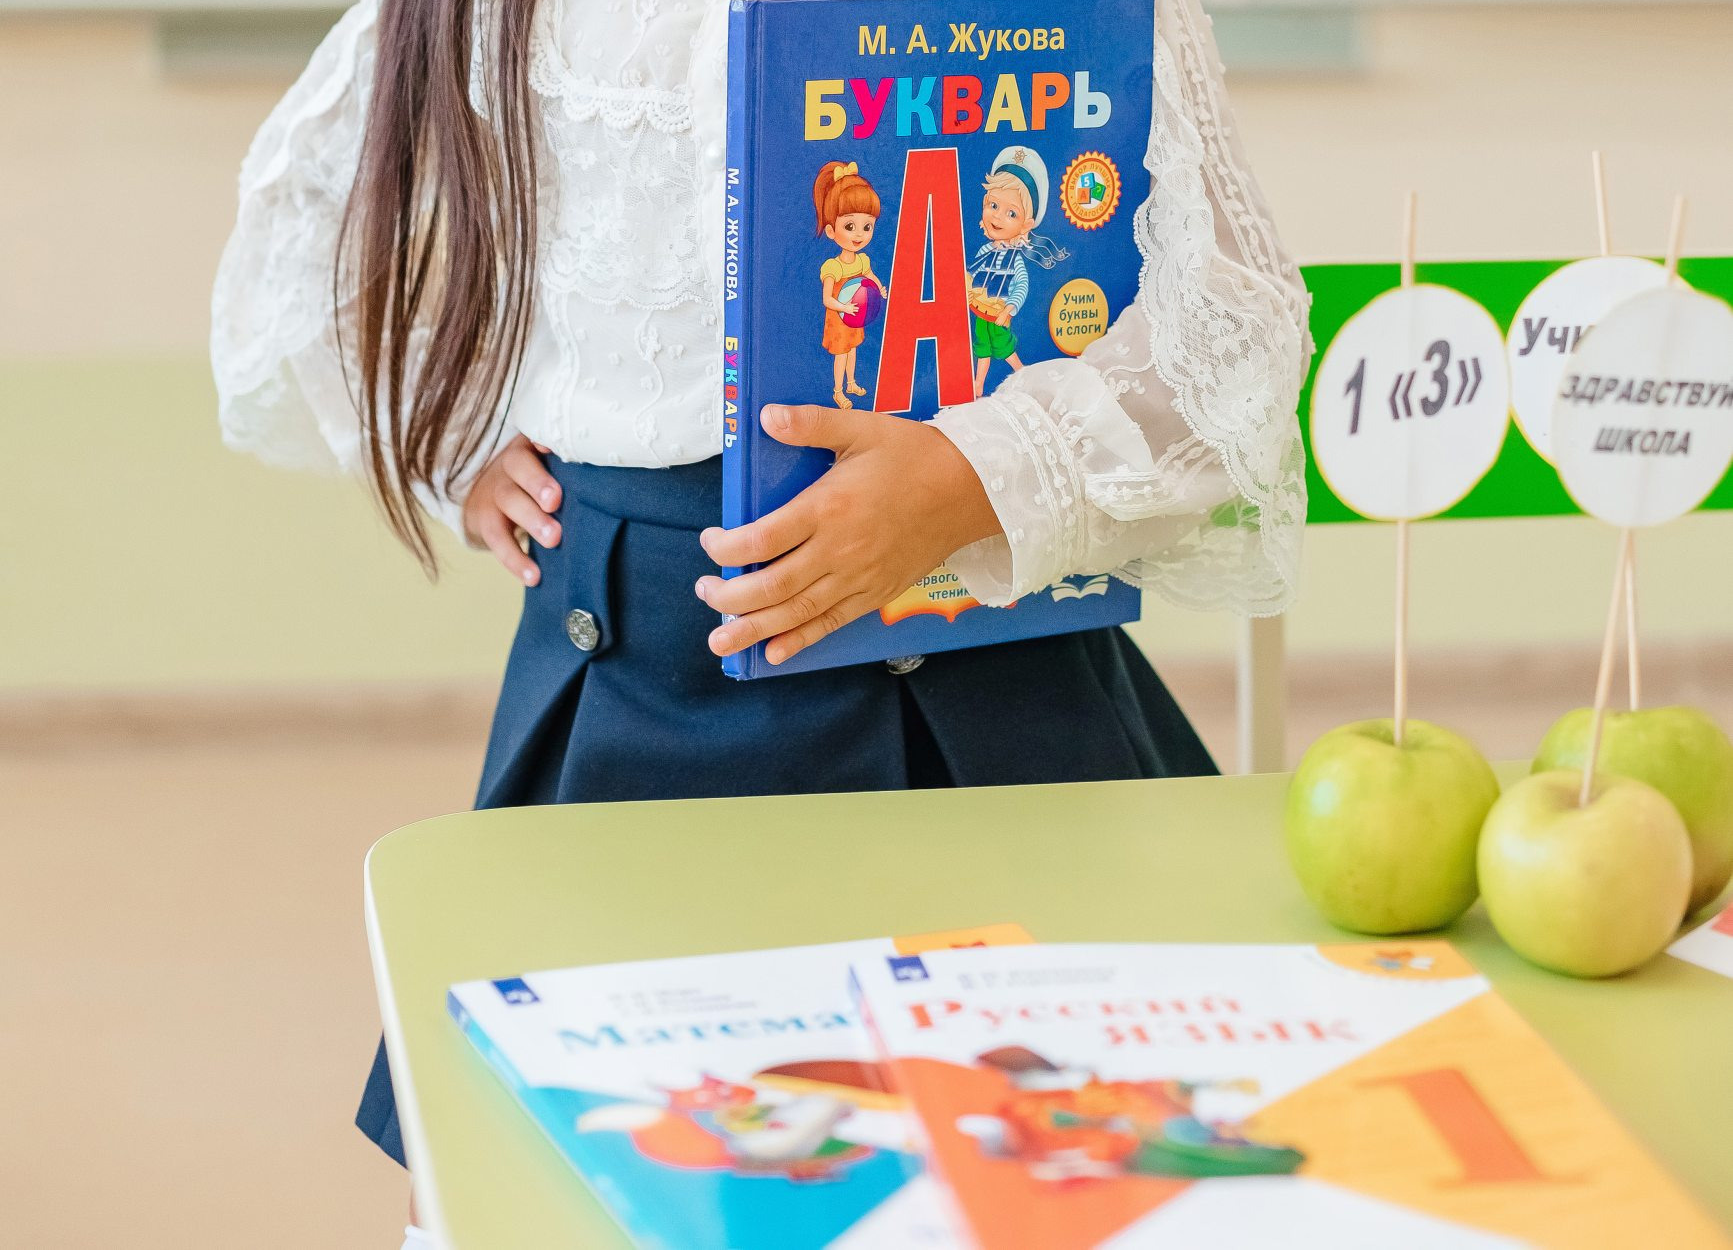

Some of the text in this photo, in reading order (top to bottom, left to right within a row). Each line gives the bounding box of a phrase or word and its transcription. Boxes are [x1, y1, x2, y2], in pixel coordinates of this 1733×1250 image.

[857, 22, 1066, 61] М. А. Жукова
[803, 70, 1113, 142] БУКВАРЬ
[726, 168, 740, 301] М. А. ЖУКОВА
[1059, 308, 1098, 323] буквы
[1063, 293, 1095, 305] Учим
[1056, 324, 1102, 336] и слоги
[724, 336, 739, 448] БУКВАРЬ
[1342, 357, 1367, 436] 1
[1592, 426, 1692, 456] ШКОЛА
[912, 573, 959, 589] ервого
[556, 1011, 849, 1052] Матема
[1357, 1065, 1598, 1187] 1
